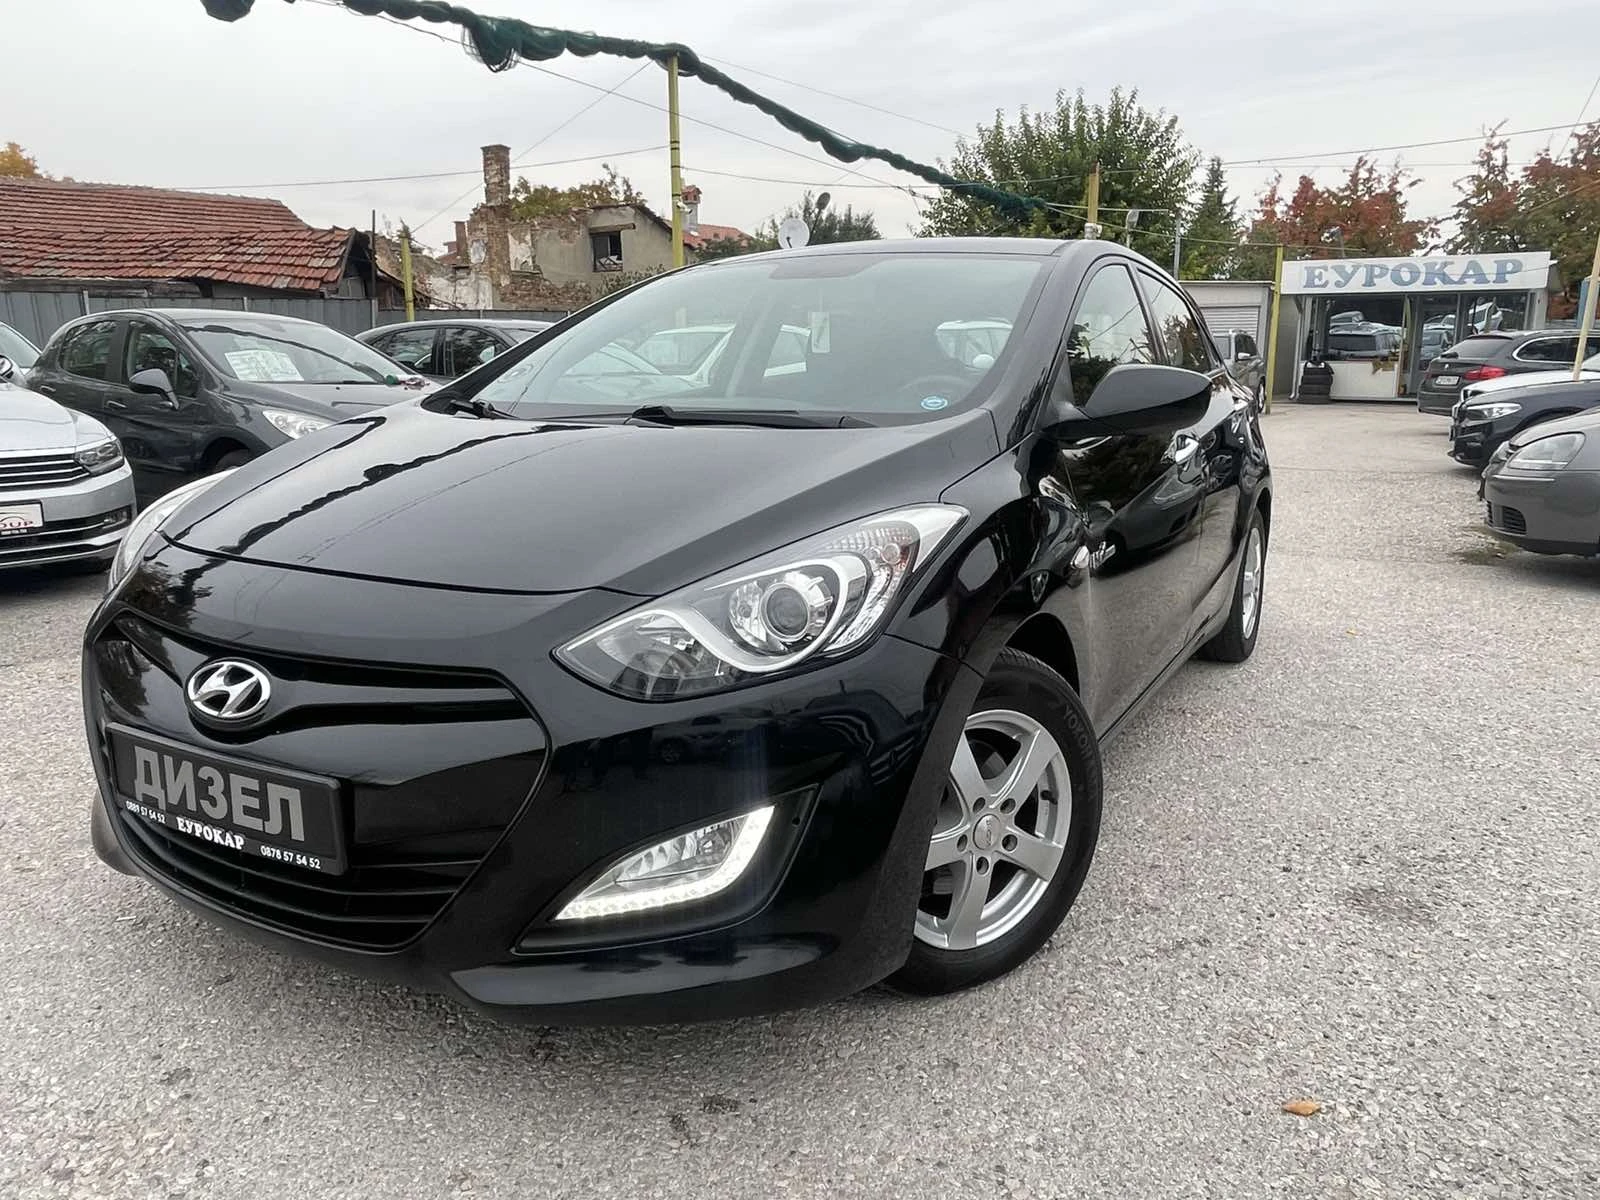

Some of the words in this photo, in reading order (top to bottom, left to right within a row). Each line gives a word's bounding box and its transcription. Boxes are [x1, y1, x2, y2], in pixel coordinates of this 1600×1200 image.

[1303, 259, 1523, 289] ЕУРОКАР
[134, 746, 305, 841] ДИЗЕЛ
[176, 816, 245, 850] ЕУРОКАР
[260, 845, 282, 860] 0878
[283, 850, 294, 863] 57
[295, 853, 308, 867] 54
[309, 856, 321, 870] 52
